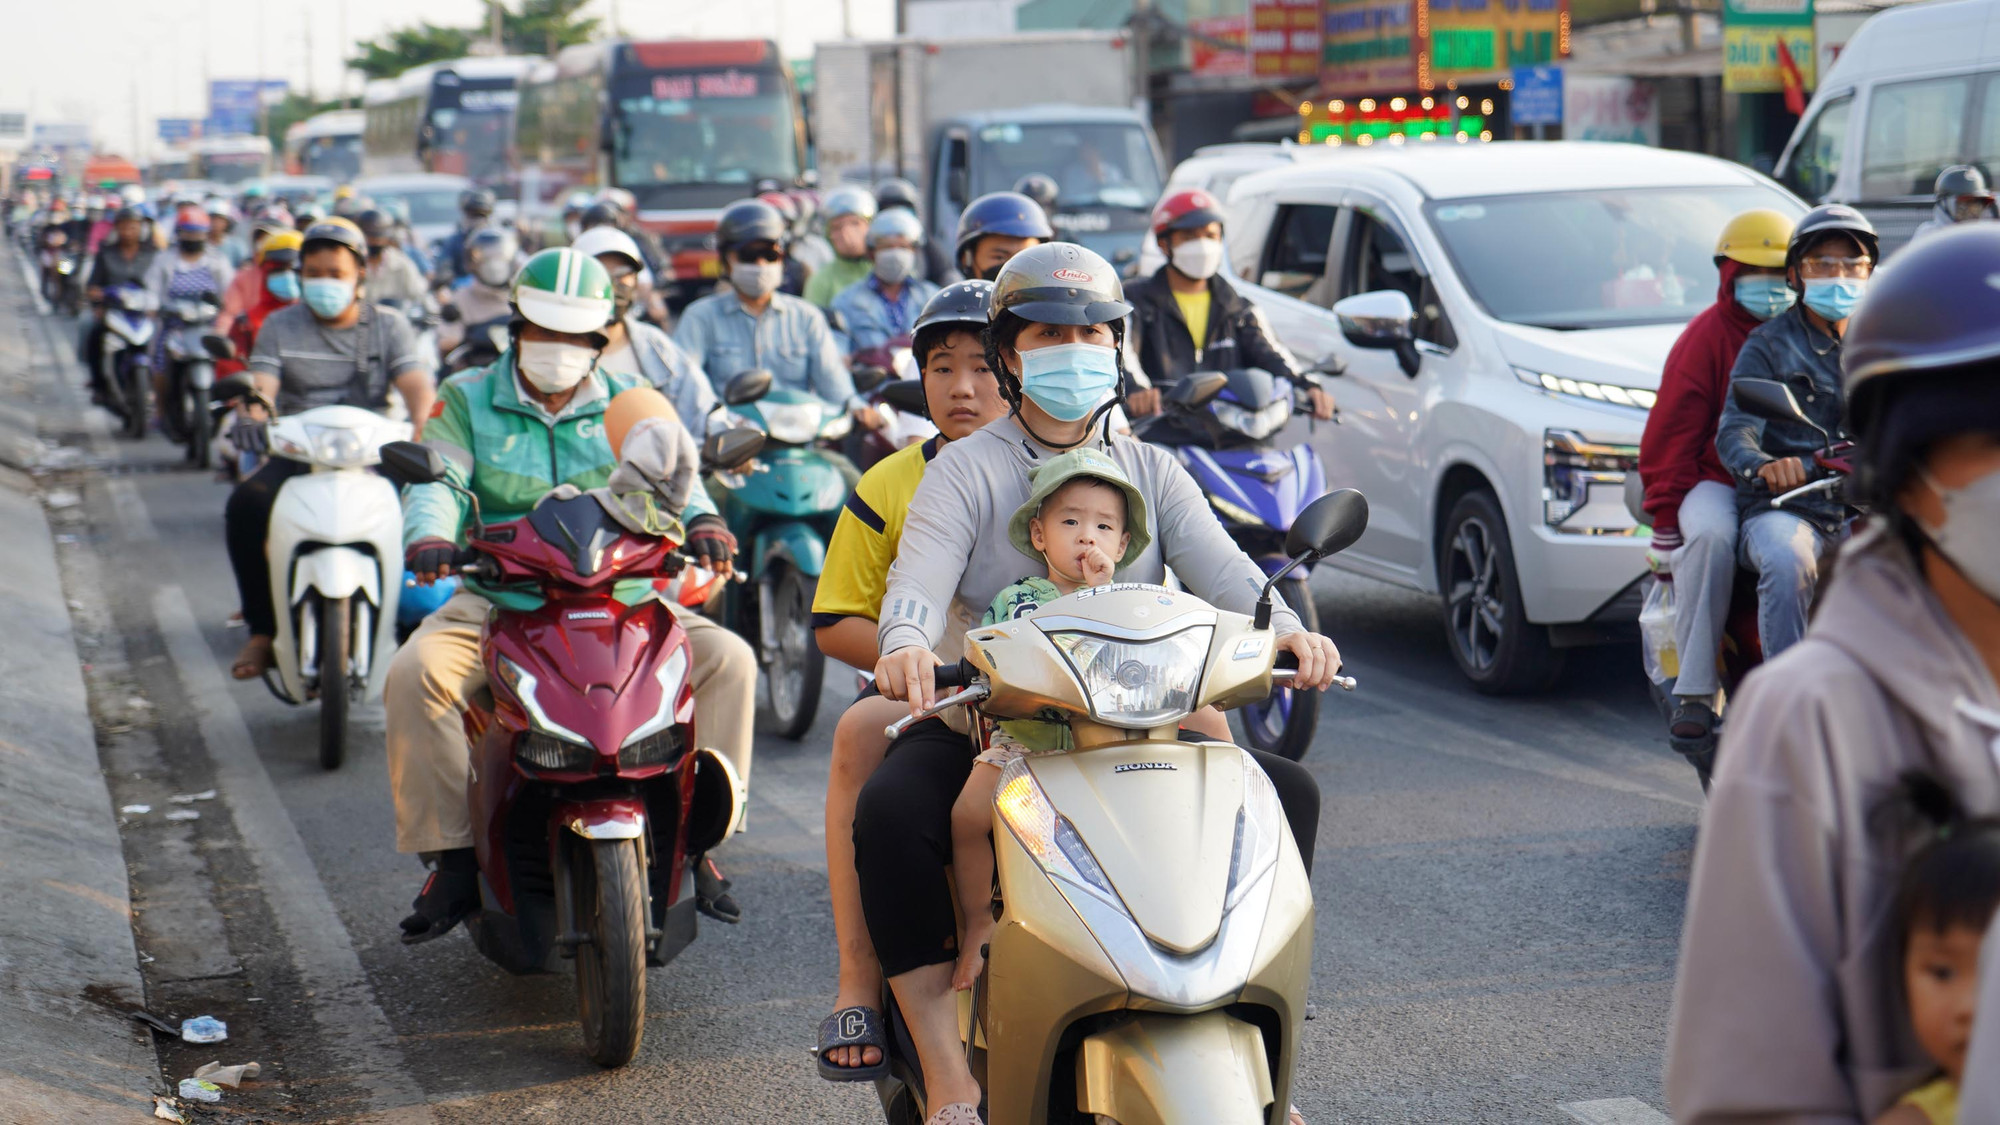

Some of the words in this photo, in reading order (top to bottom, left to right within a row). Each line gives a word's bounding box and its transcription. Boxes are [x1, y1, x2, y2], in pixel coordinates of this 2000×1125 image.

[568, 611, 609, 620] HONDA
[1115, 763, 1177, 773] HONDA
[839, 1008, 867, 1041] G
